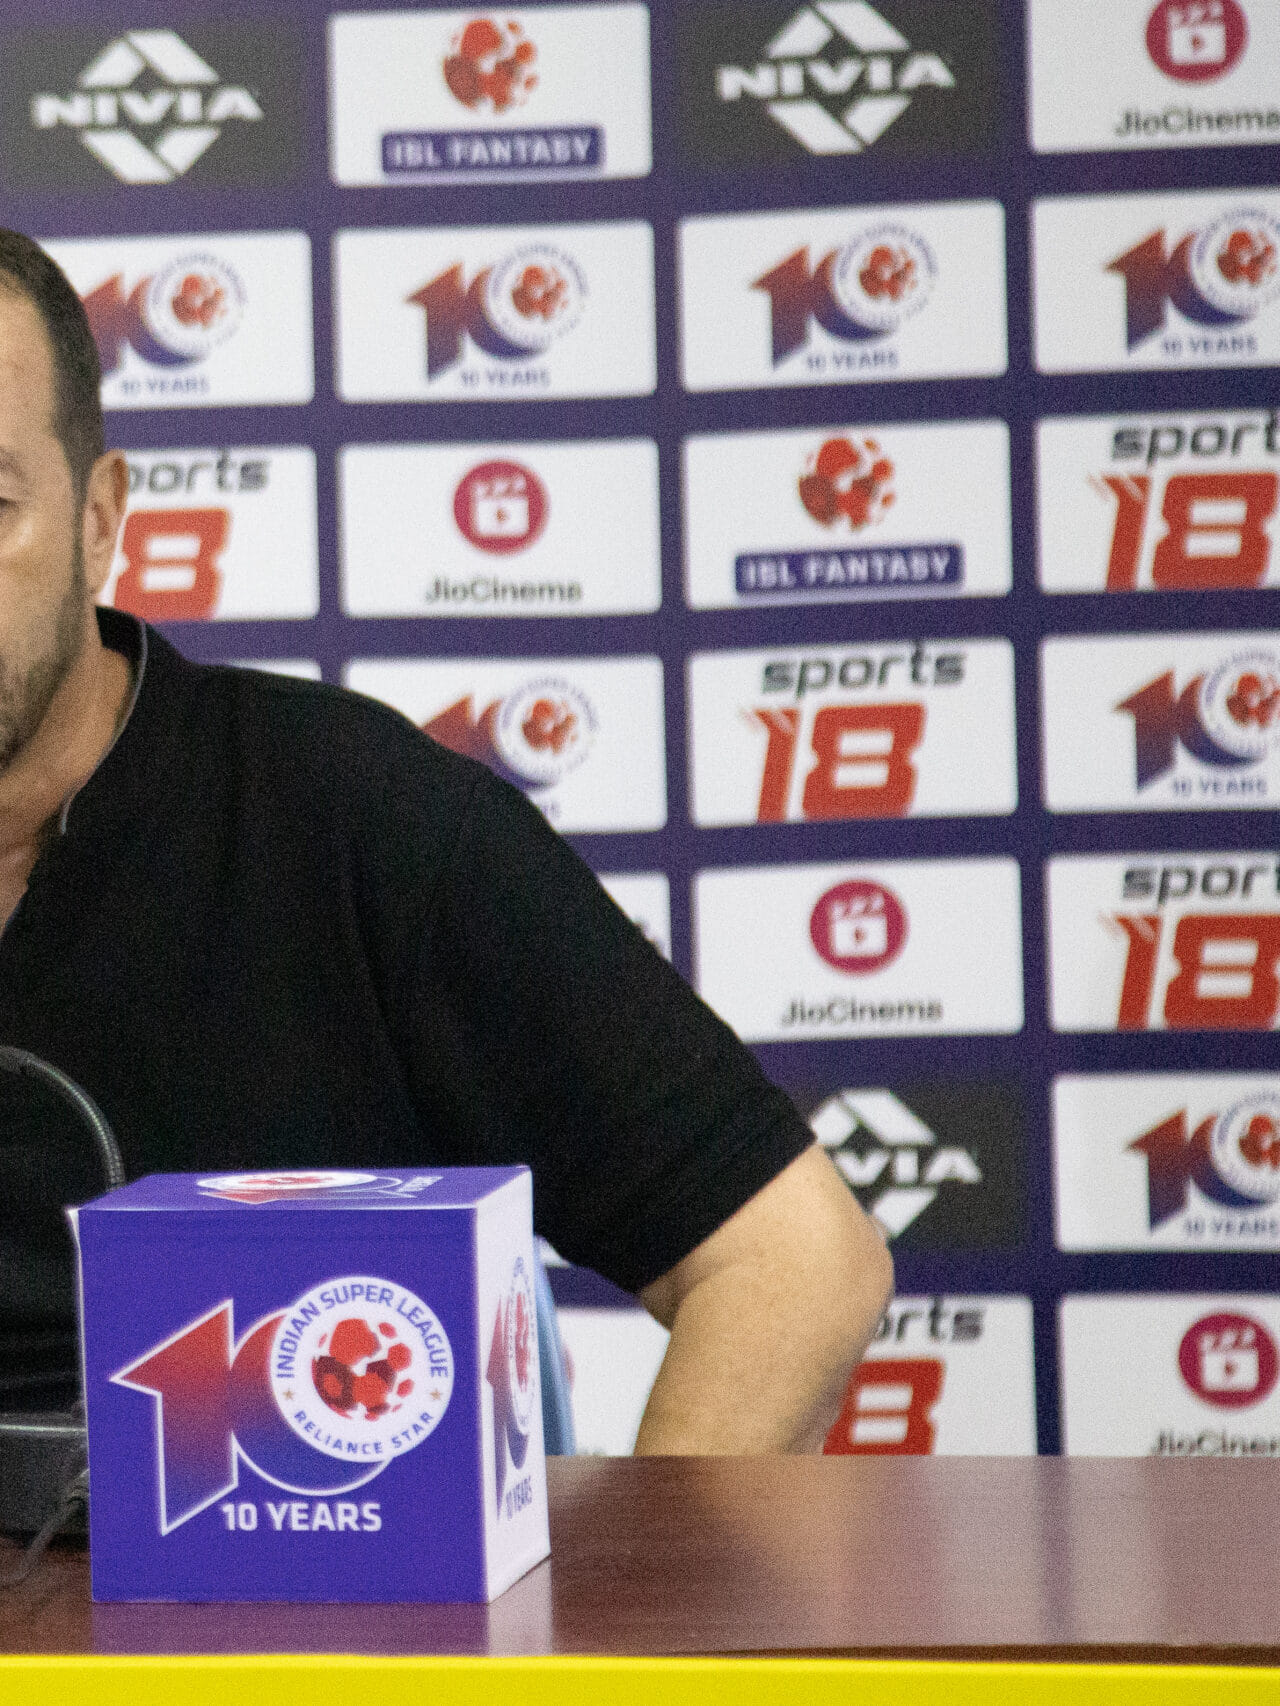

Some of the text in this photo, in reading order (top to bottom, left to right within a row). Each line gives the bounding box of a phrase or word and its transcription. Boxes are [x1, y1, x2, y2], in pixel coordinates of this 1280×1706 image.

[718, 54, 956, 99] NIVIA
[32, 87, 264, 128] NIVIA
[1115, 106, 1280, 137] JioCinema
[451, 136, 591, 164] FANTASY
[1090, 473, 1280, 592] 18
[422, 575, 583, 604] JioCinema
[742, 554, 951, 589] ISL FANTASY
[762, 641, 967, 700] sports
[740, 702, 928, 823] 18
[1098, 914, 1280, 1031] 18
[780, 997, 943, 1027] JioCinema
[835, 1148, 984, 1185] VIA
[276, 1301, 322, 1379] INDIAN
[320, 1283, 395, 1310] SUPER
[396, 1297, 449, 1378] LEAGUE
[293, 1409, 434, 1455] RELIANCE STAR
[221, 1502, 382, 1532] 10 YEARS
